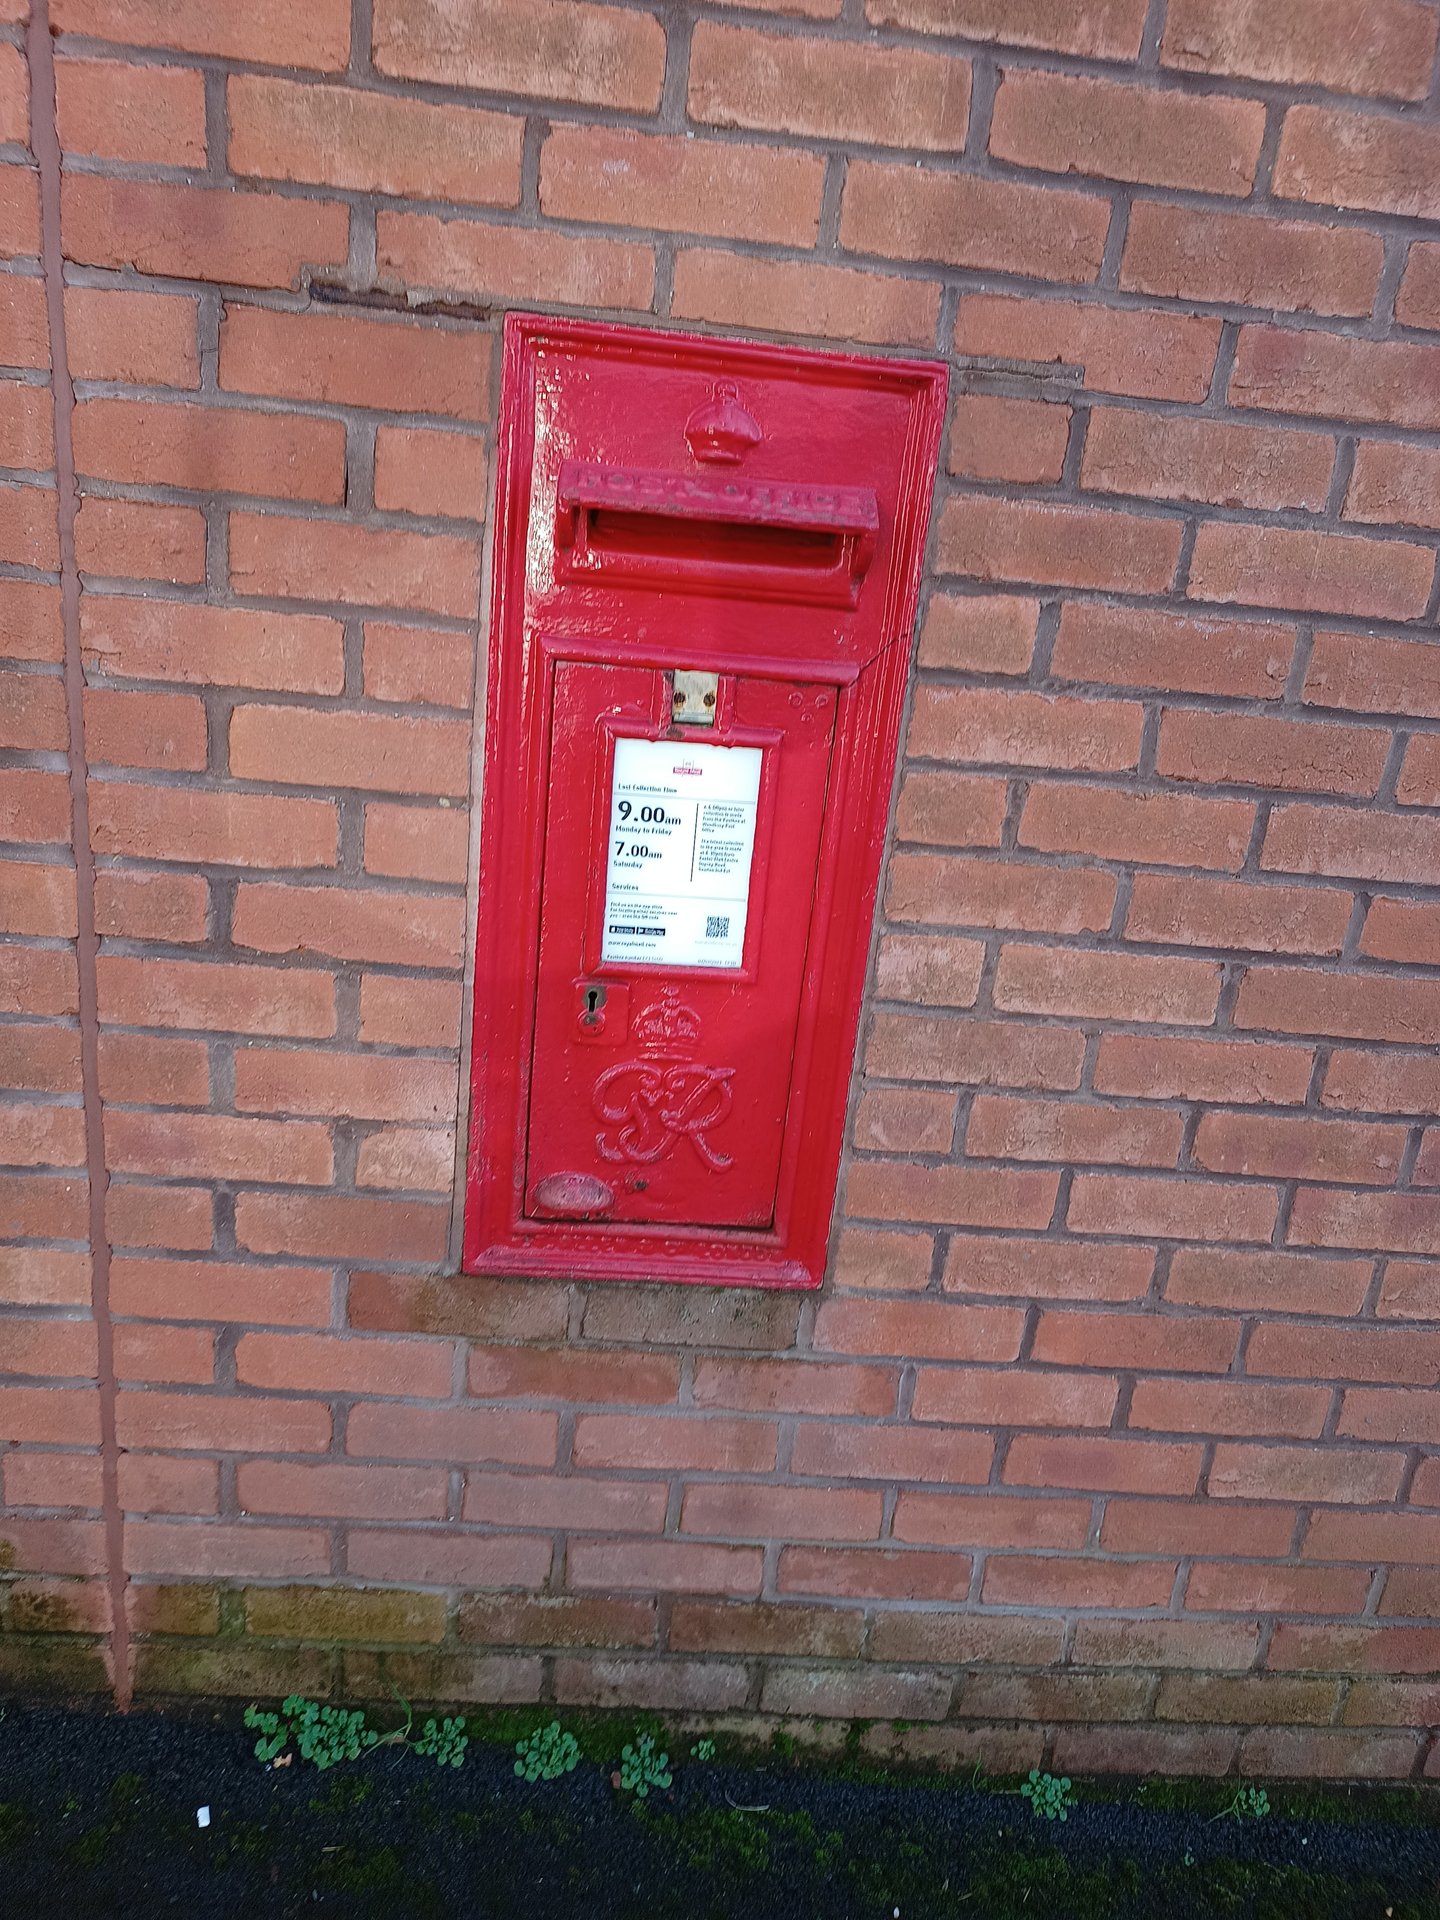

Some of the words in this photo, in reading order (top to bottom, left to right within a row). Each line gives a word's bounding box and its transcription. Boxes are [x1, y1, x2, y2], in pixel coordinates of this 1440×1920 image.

[619, 782, 630, 790] Last
[633, 784, 661, 792] Collection
[618, 801, 681, 825] 9.00am
[616, 825, 641, 834] Monday
[615, 841, 662, 859] 7.00am
[614, 860, 642, 869] Saturday
